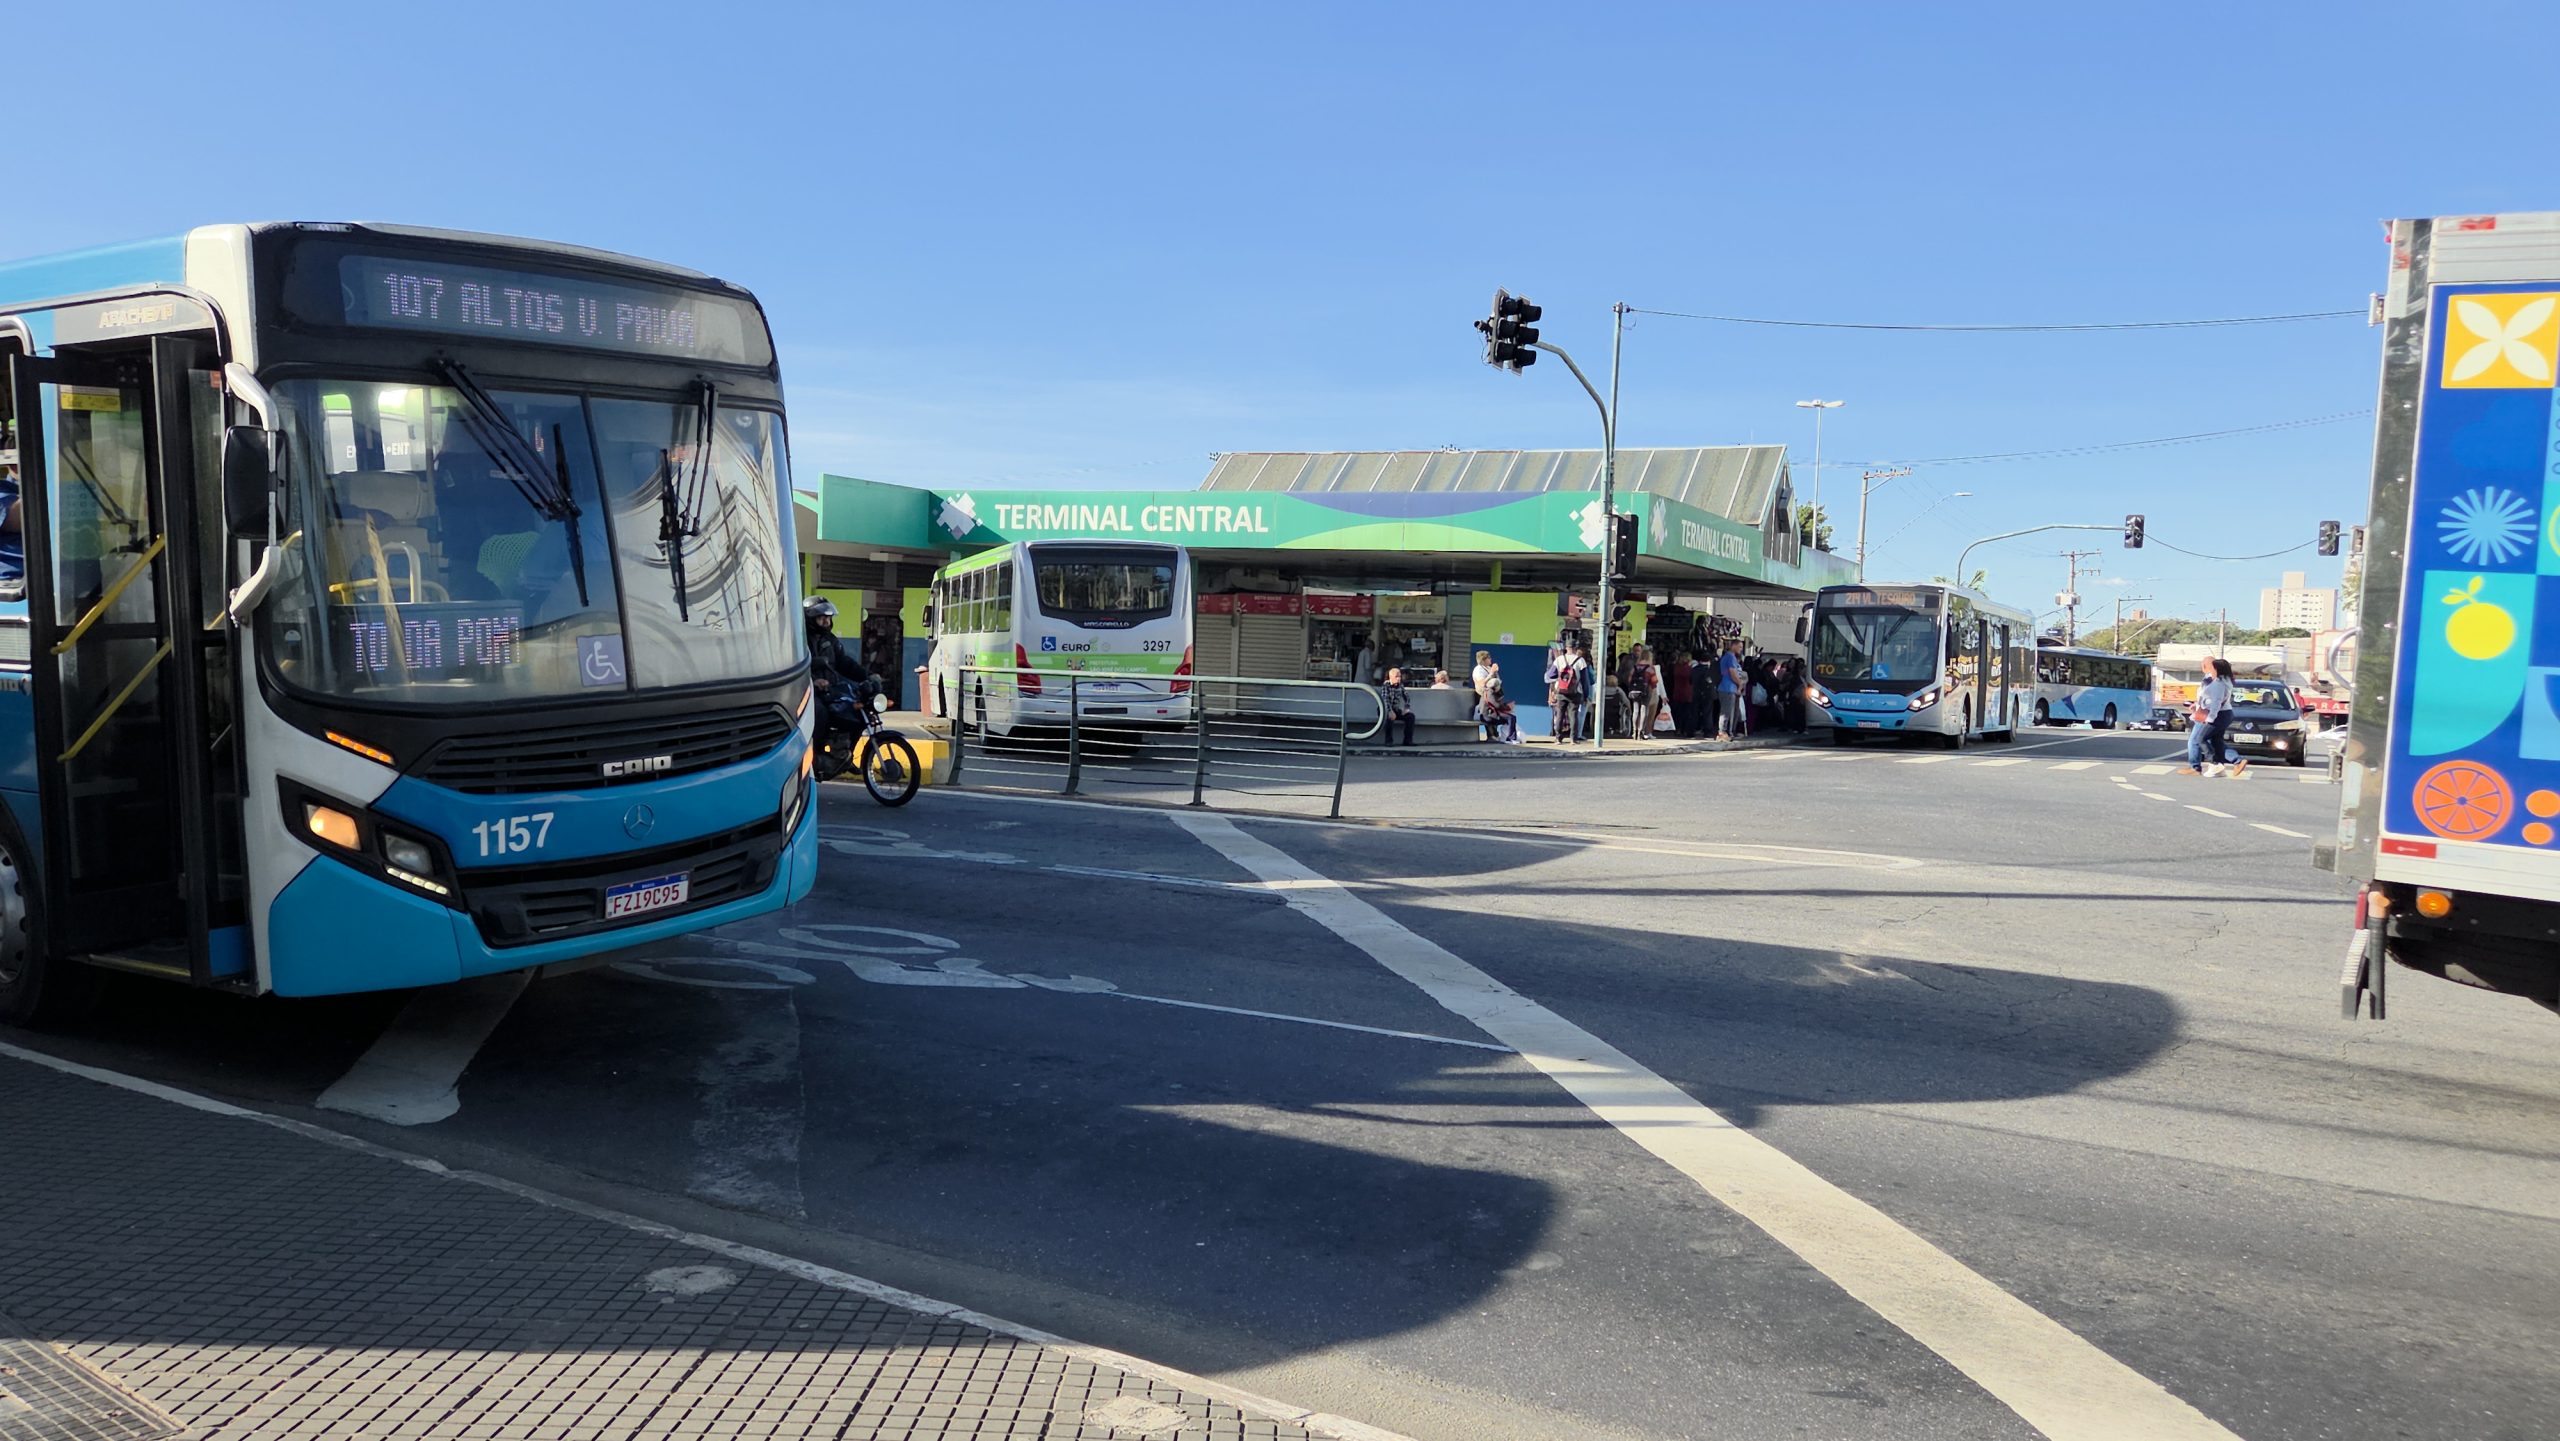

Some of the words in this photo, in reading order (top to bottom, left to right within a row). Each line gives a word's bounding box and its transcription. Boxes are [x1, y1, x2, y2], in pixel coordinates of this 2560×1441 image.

[383, 272, 444, 321] 107
[459, 282, 566, 333] ALTOS
[994, 503, 1134, 532] TERMINAL
[1140, 504, 1269, 533] CENTRAL
[1681, 519, 1720, 556] TERMINAL
[1721, 532, 1751, 563] CENTRAL
[1142, 640, 1171, 652] 3297
[602, 755, 672, 777] CAIO
[472, 811, 554, 857] 1157
[613, 883, 680, 915] FZI9C95
